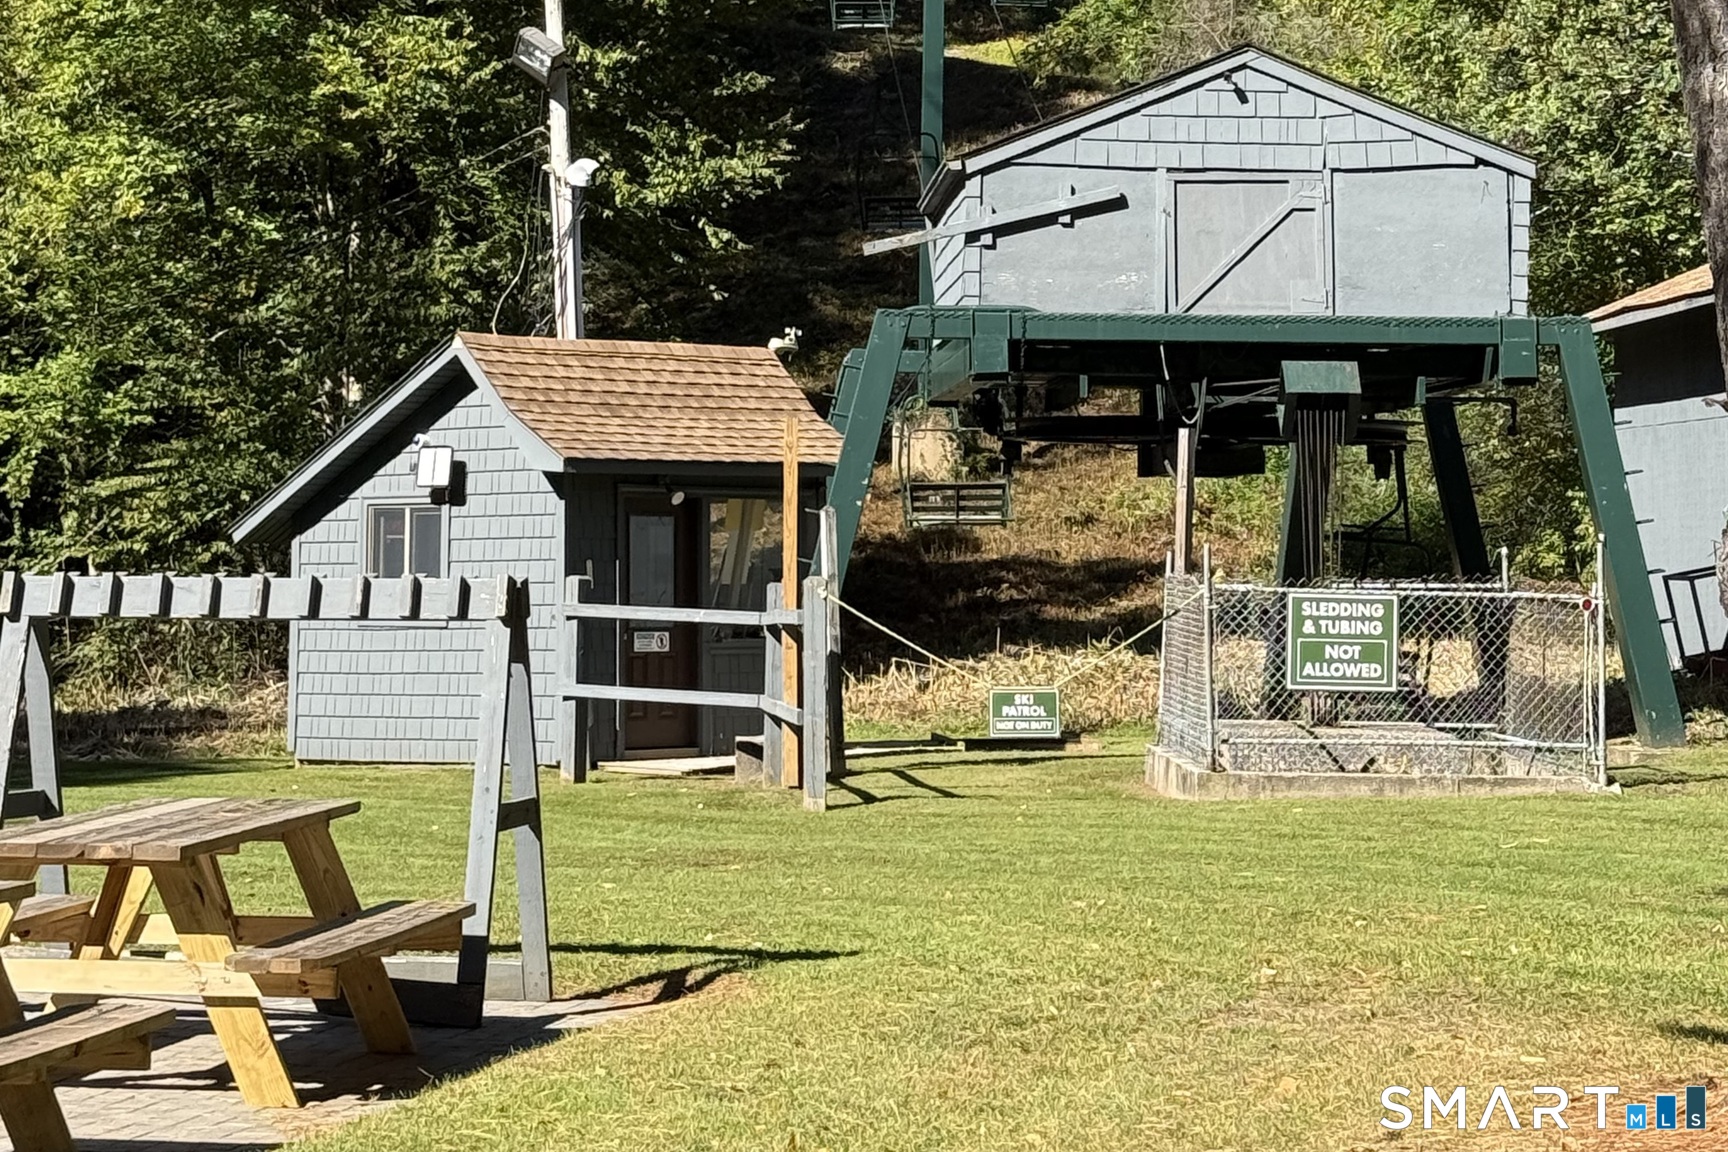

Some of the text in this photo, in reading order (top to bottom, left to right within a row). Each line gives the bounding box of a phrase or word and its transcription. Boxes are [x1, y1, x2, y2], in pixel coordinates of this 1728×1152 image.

[1301, 601, 1385, 617] SLEDDING
[1302, 619, 1383, 635] & TUBING
[1325, 644, 1362, 659] NOT
[1302, 662, 1382, 678] ALLOWED
[1014, 694, 1034, 705] SKI
[1002, 705, 1047, 716] PATROL
[1015, 721, 1030, 730] ON
[1030, 721, 1053, 730] DUTY
